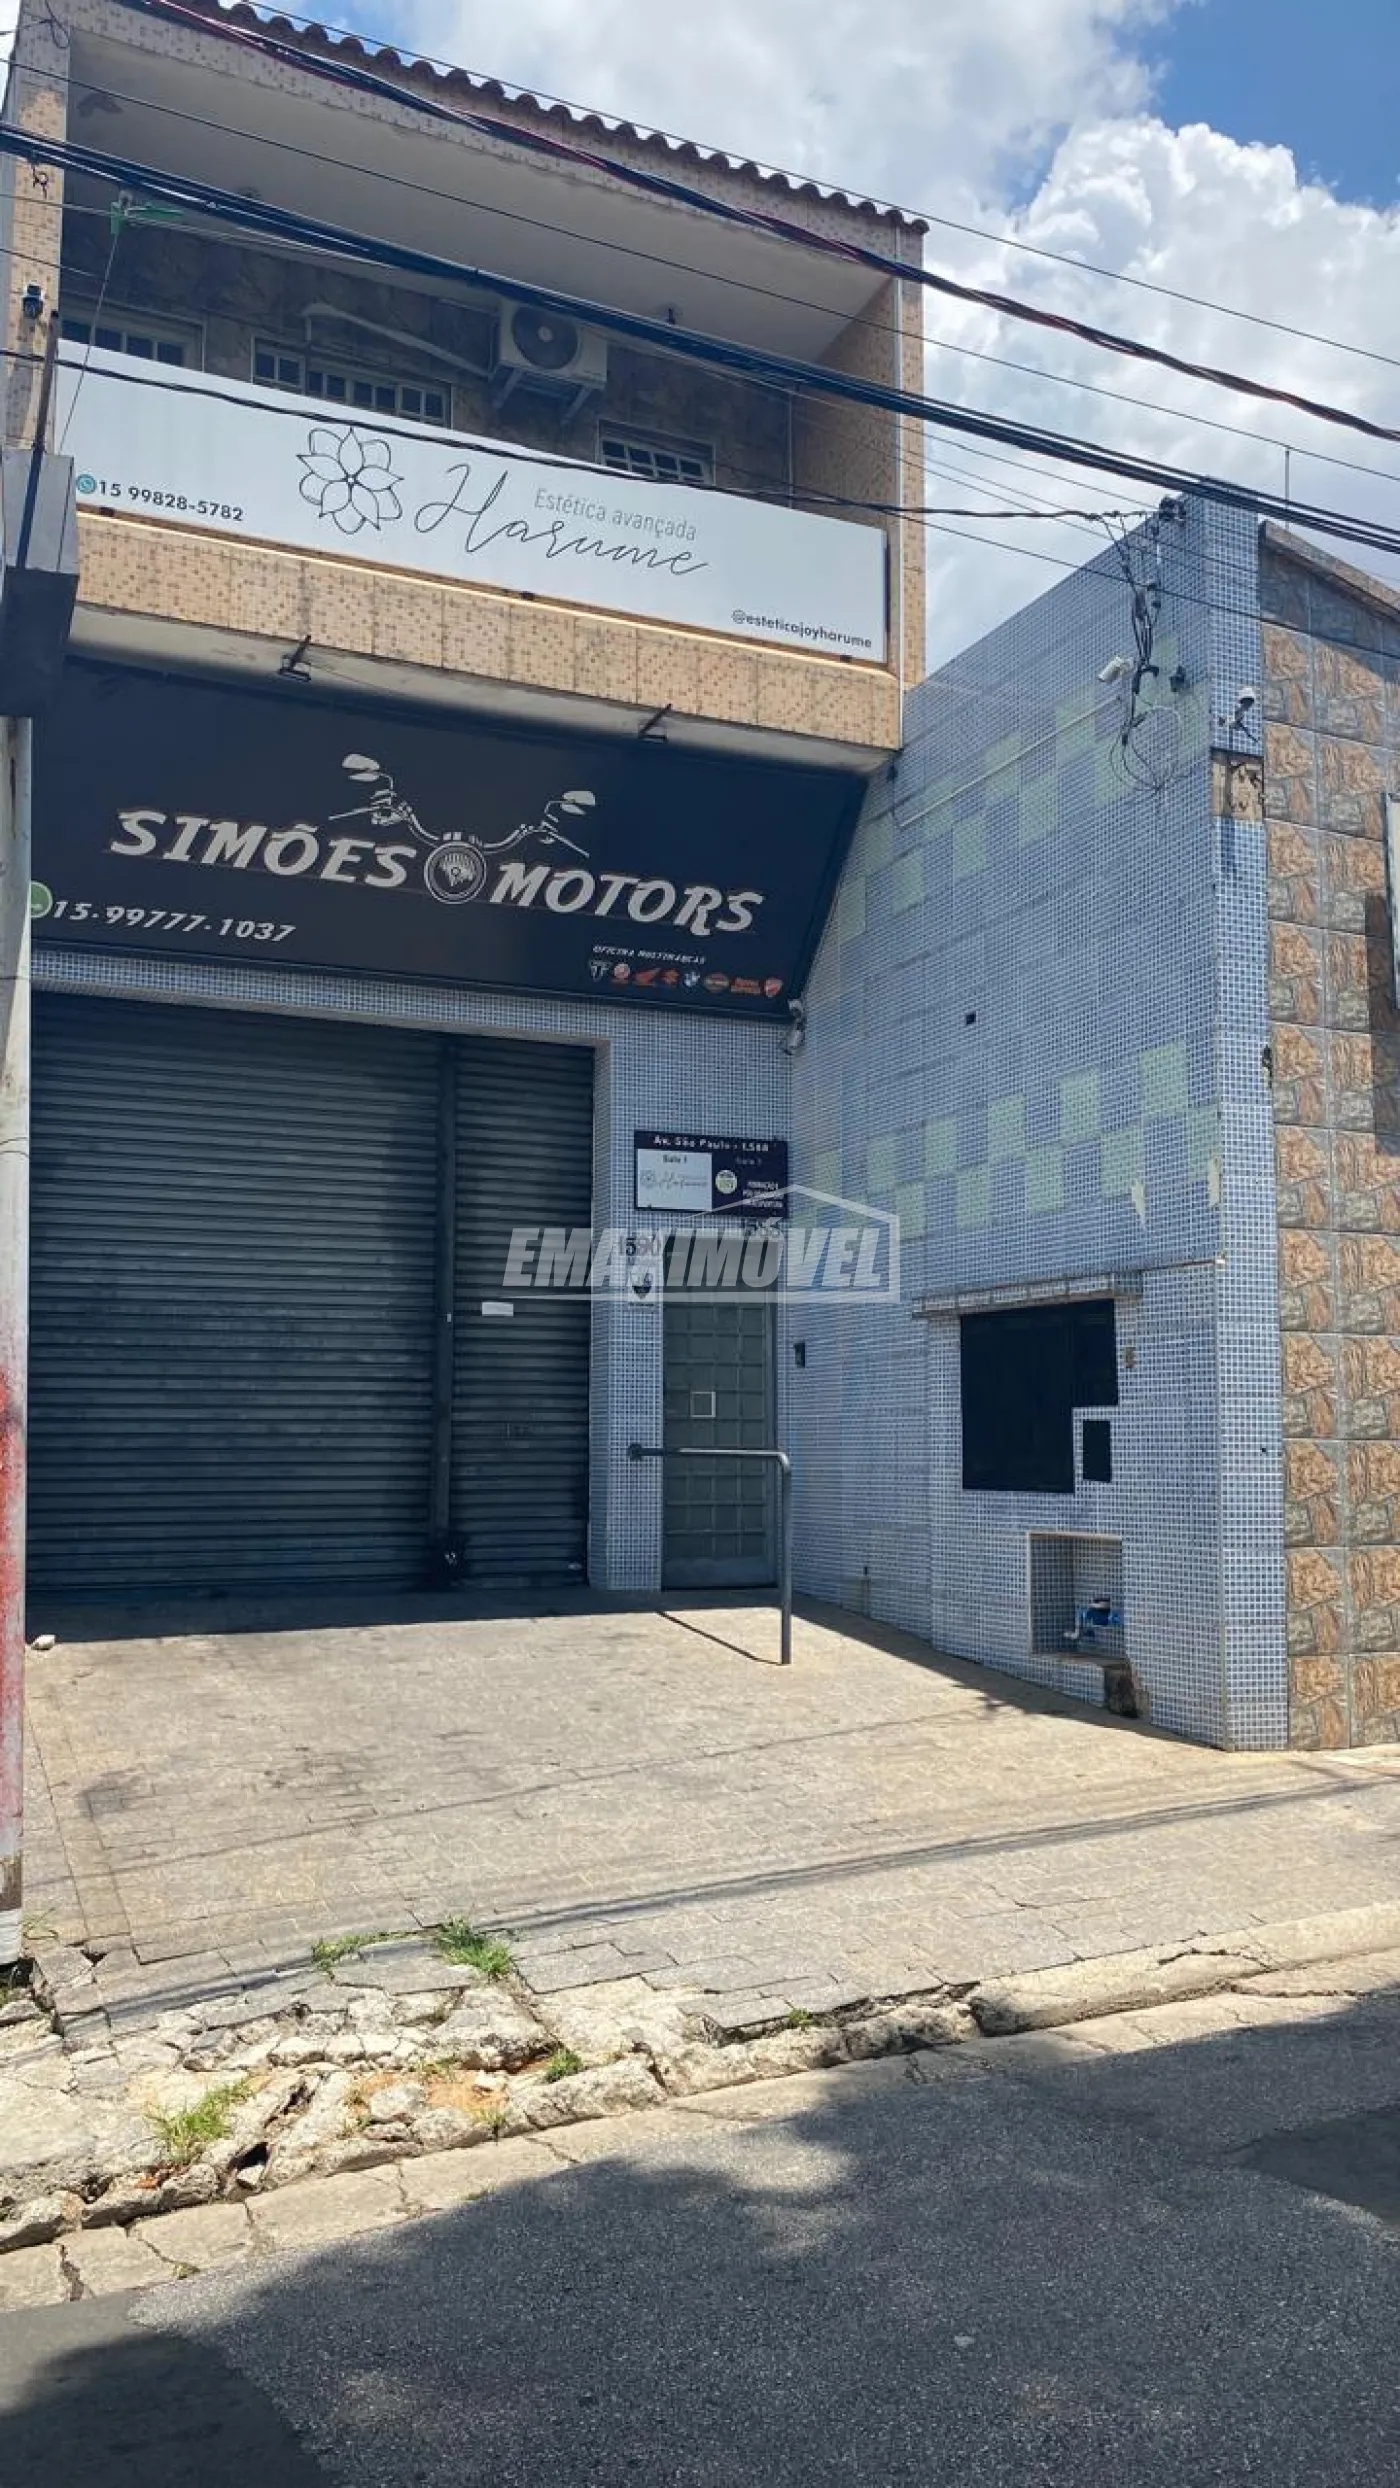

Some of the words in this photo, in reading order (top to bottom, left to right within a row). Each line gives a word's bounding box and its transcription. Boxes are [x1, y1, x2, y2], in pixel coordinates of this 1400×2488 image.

[99, 480, 121, 497] 15
[128, 486, 243, 521] 99828-5782
[414, 463, 709, 575] Harume
[535, 487, 606, 523] Estética
[612, 508, 697, 541] avançada
[110, 809, 417, 888] SIMÕES
[490, 862, 765, 936] MOTORS
[675, 1136, 695, 1147] São
[700, 1139, 730, 1149] Paulo
